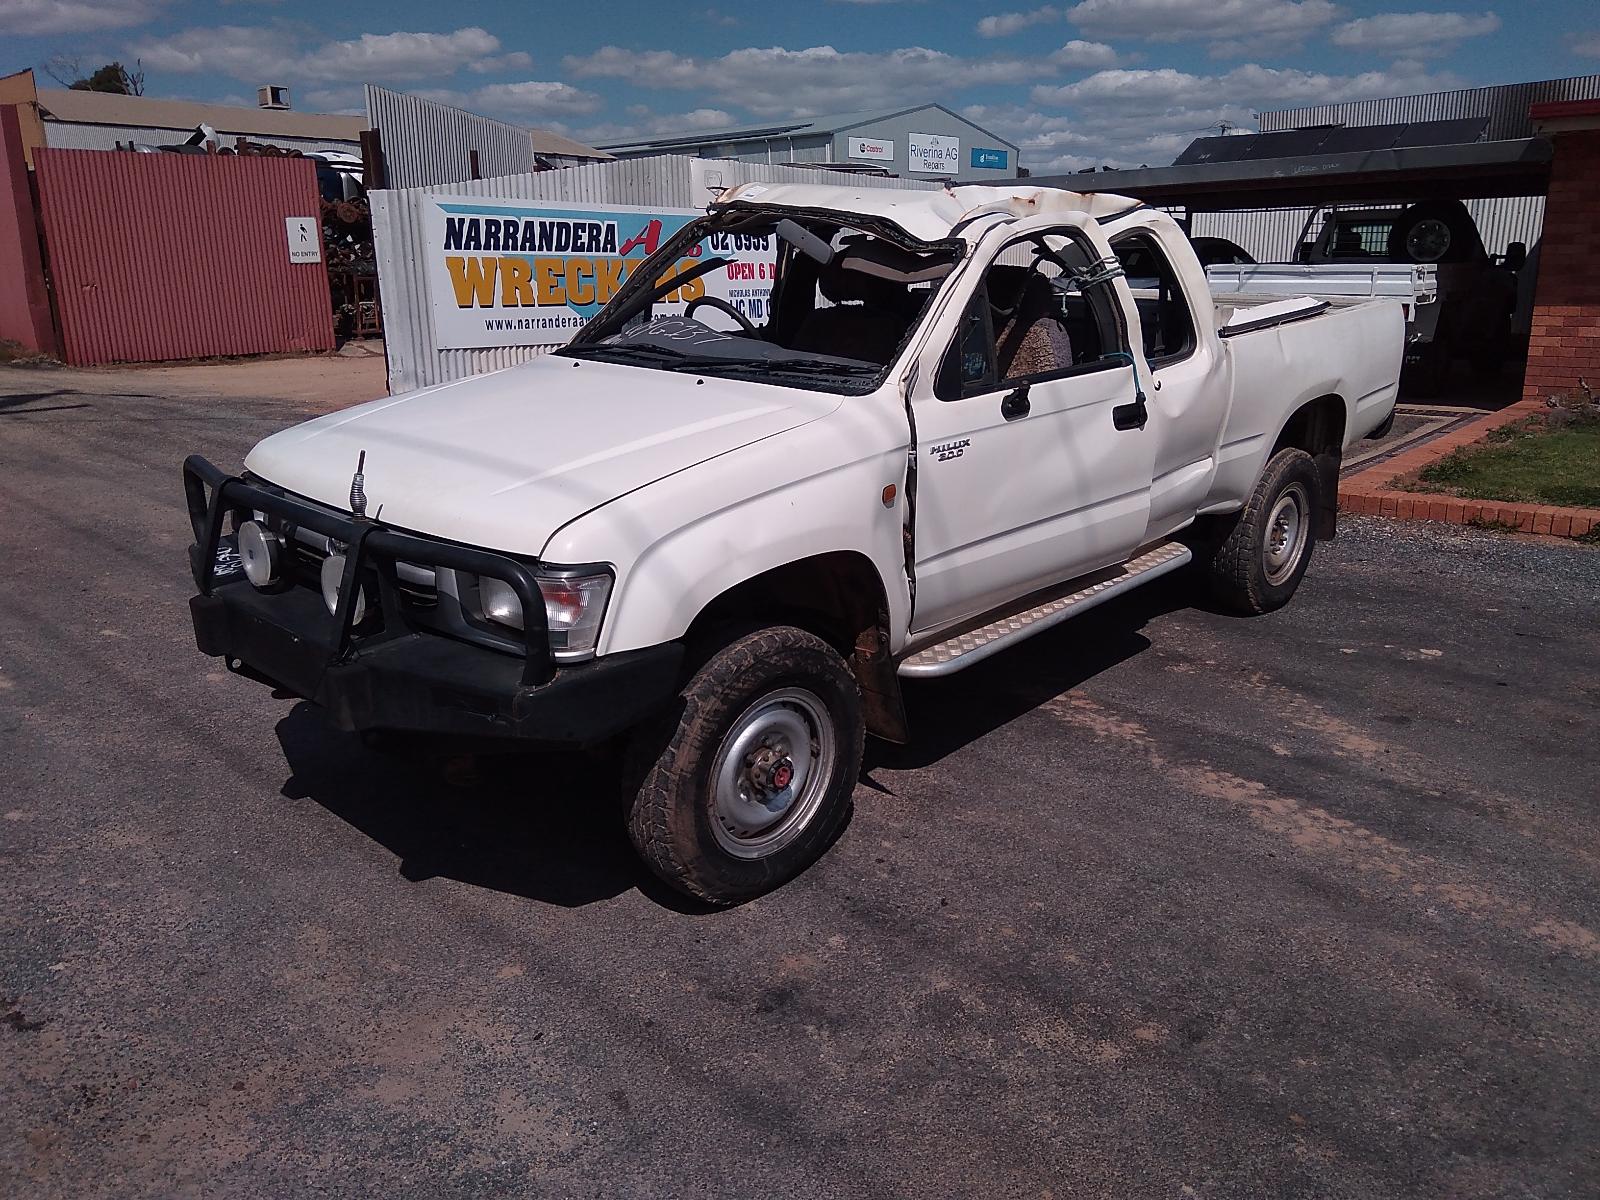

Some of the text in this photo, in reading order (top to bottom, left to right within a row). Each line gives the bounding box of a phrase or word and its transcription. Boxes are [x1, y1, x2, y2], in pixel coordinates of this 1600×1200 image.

[910, 144, 958, 160] Riverina AG
[923, 159, 945, 171] Repairs
[443, 217, 617, 253] NARRANDERA
[727, 262, 755, 280] OPEN
[758, 262, 766, 280] 6
[445, 256, 706, 309] WRECKRS
[748, 298, 763, 318] MD
[929, 438, 971, 456] HILUX
